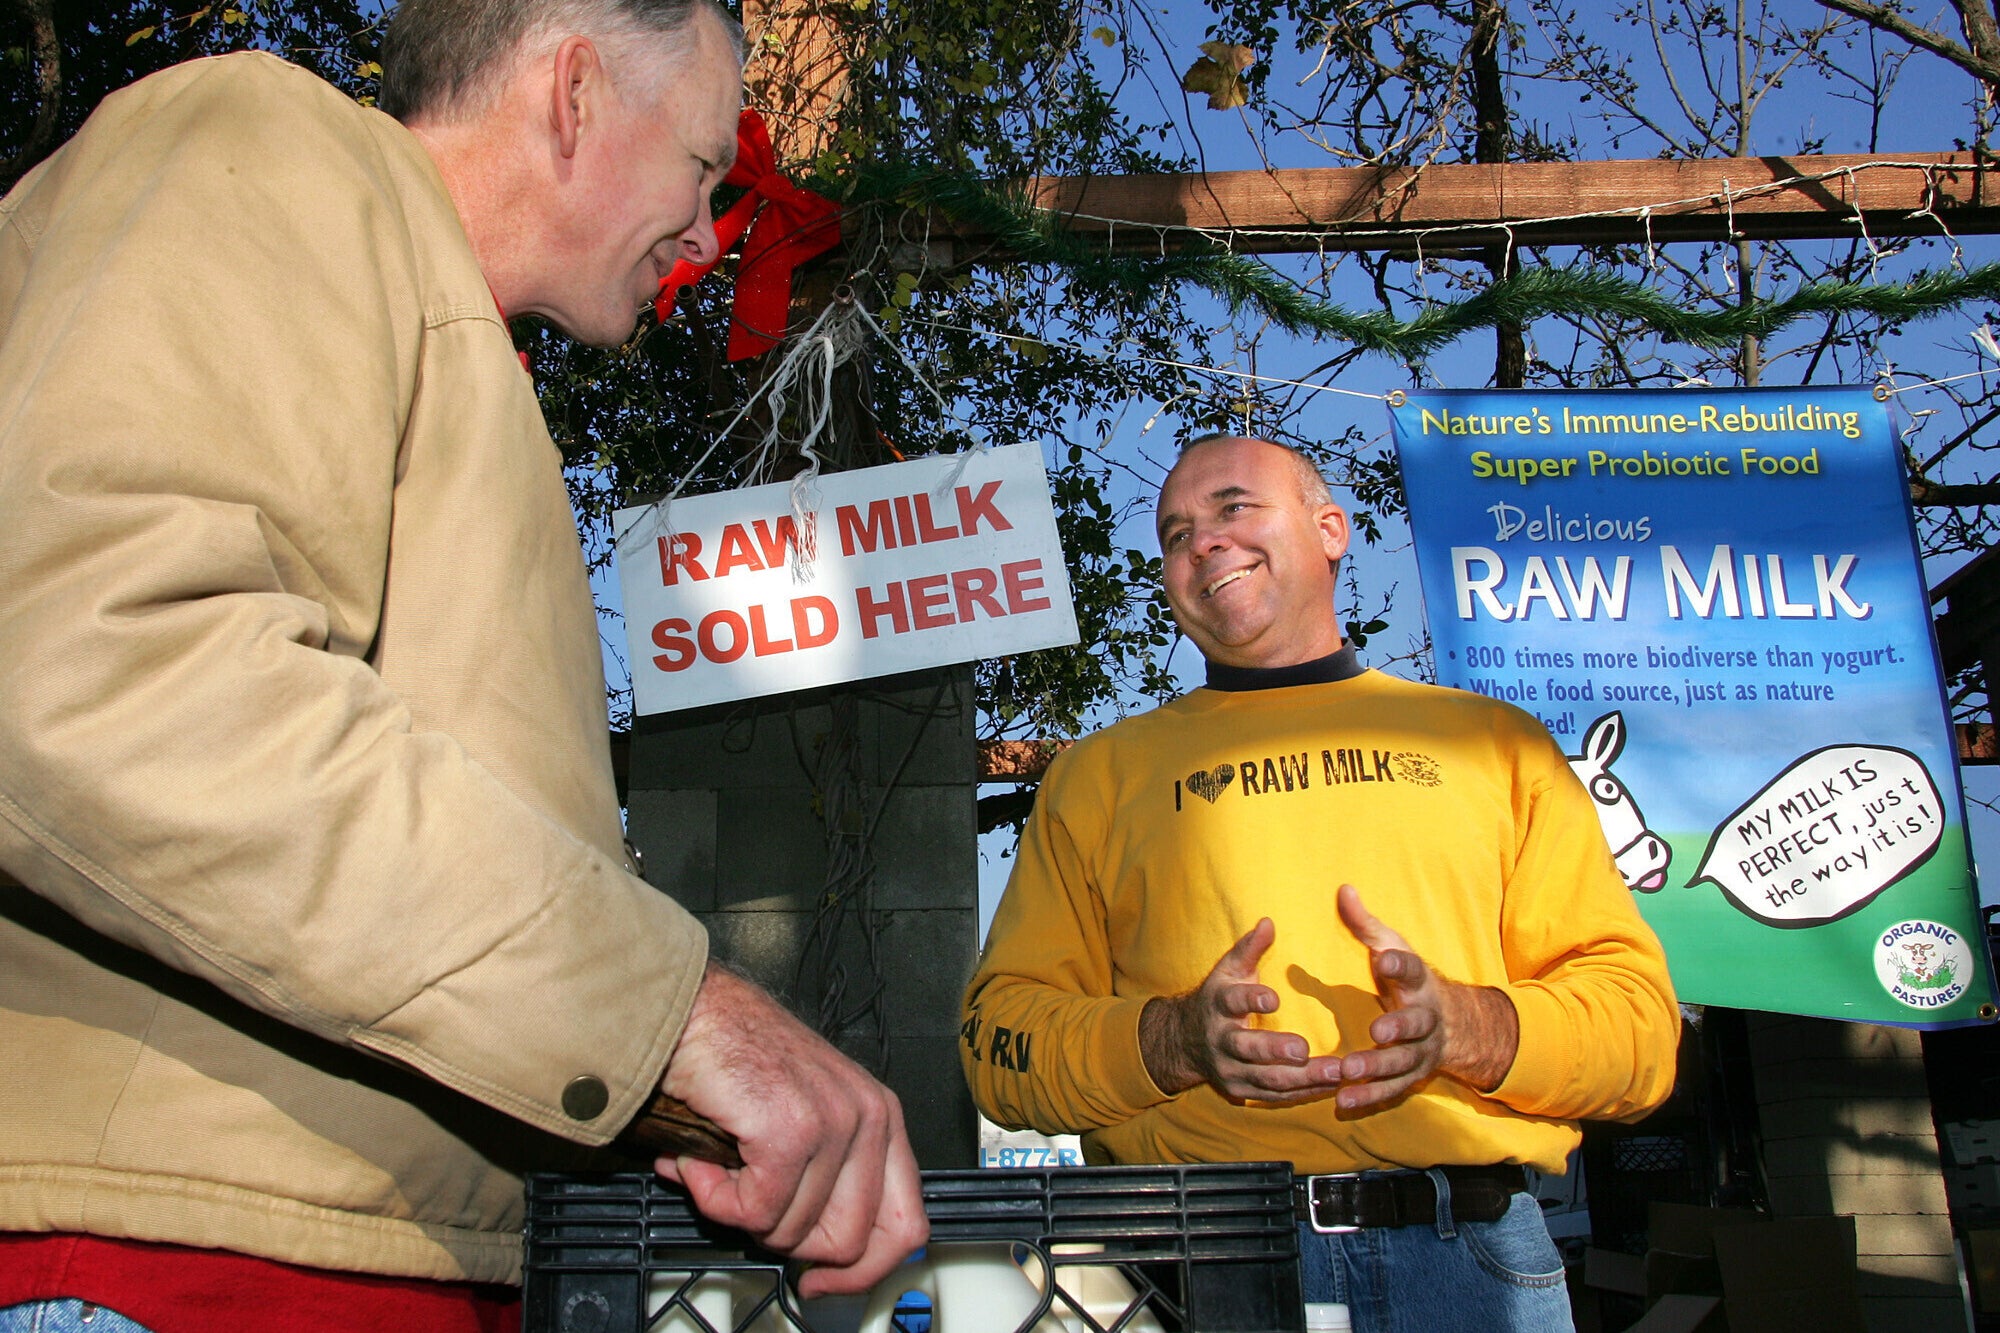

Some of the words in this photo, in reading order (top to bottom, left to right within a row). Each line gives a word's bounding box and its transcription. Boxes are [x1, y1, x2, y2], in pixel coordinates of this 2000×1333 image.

[1421, 407, 1552, 437] Nature's
[1563, 405, 1860, 440] Immune-Rebuilding
[1470, 450, 1577, 485] Super
[1588, 449, 1730, 477] Probiotic
[1741, 447, 1819, 476] Food
[657, 510, 817, 587] RAW
[834, 479, 1014, 557] MILK
[1486, 501, 1652, 543] Delicious
[1450, 545, 1632, 621] RAW
[1659, 544, 1871, 620] MILK
[651, 594, 839, 673] SOLD
[855, 557, 1052, 640] HERE
[1466, 645, 1506, 669] 800
[1514, 646, 1575, 669] times
[1583, 651, 1639, 669] more
[1646, 645, 1758, 669] biodiverse
[1765, 644, 1814, 668] than
[1821, 643, 1905, 675] yogurt.
[1469, 678, 1538, 701] Whole
[1546, 678, 1595, 702] food
[1602, 683, 1680, 706] source,
[1684, 678, 1727, 708] just
[1735, 683, 1758, 701] as
[1765, 680, 1835, 701] nature
[1239, 752, 1310, 797] RAW
[1320, 748, 1396, 786] MILK
[1737, 808, 1772, 846] MY
[1778, 777, 1843, 824] MILK
[1839, 759, 1878, 791] IS
[1862, 777, 1920, 828] just
[1765, 878, 1808, 908] the
[1811, 845, 1869, 882] way
[1867, 828, 1896, 852] it
[1891, 804, 1935, 839] is!
[1882, 922, 1957, 947] ORGANIC
[1891, 983, 1963, 1007] PASTURES
